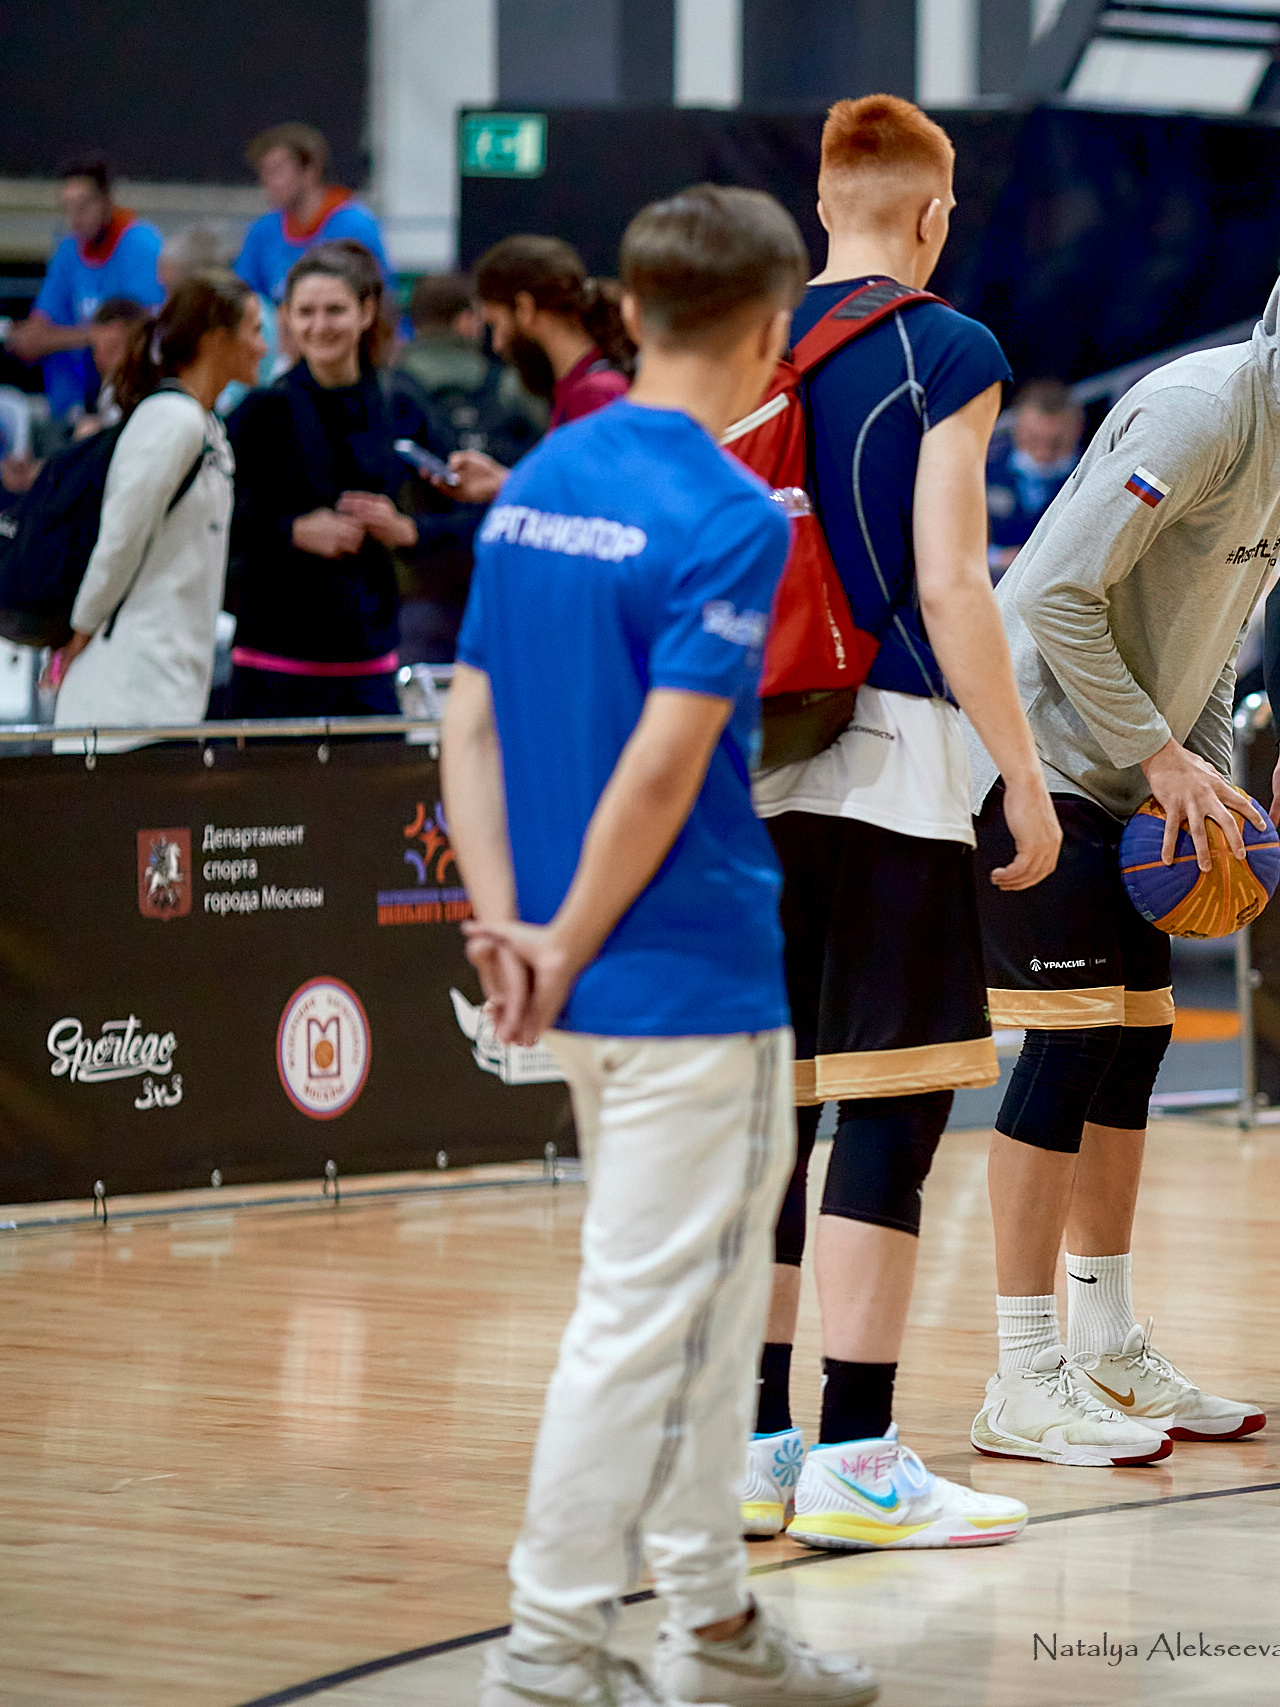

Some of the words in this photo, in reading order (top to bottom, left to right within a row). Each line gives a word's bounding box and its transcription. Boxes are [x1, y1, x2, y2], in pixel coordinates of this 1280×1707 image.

[202, 824, 305, 853] Департамент
[203, 858, 259, 884] спорта
[204, 889, 260, 917] города
[261, 884, 325, 910] Москвы
[1043, 959, 1086, 969] УРАЛСИБ
[47, 1013, 178, 1083] Sportego
[134, 1073, 183, 1110] 3x3
[841, 1453, 899, 1480] NIKE
